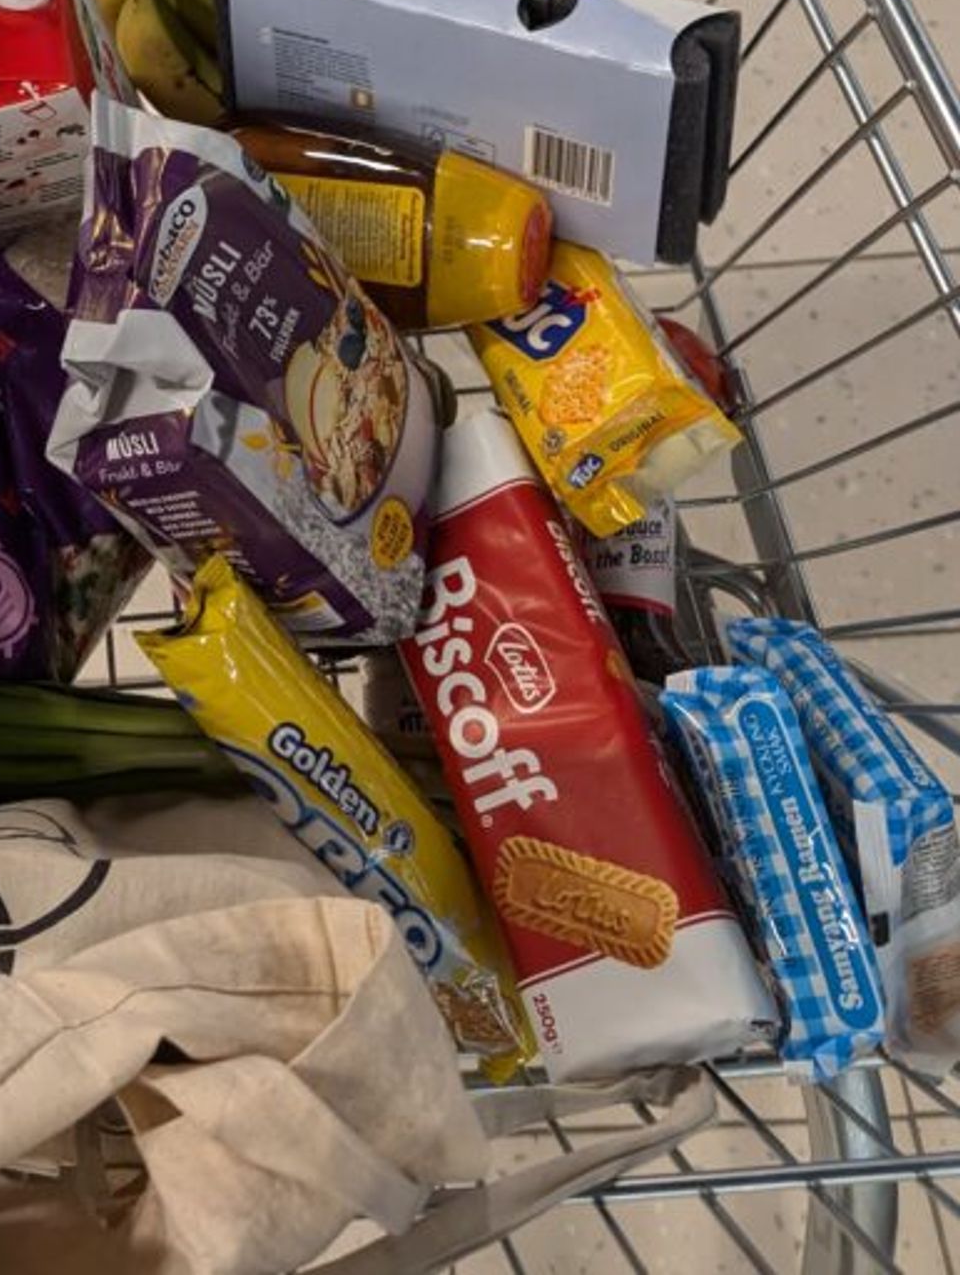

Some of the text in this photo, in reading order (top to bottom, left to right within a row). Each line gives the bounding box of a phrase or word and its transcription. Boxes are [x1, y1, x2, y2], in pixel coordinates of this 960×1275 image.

[243, 239, 274, 284] Bär
[106, 431, 160, 462] MÜSLI
[141, 461, 153, 479] &
[570, 455, 602, 487] TUC
[596, 548, 624, 569] the
[415, 556, 558, 813] Biscoff
[496, 640, 541, 703] Lotus
[743, 710, 782, 797] KYCKLING
[766, 722, 792, 775] SMAK
[271, 726, 378, 834] Golden
[781, 795, 865, 1012] Samyang Ramen
[532, 993, 558, 1043] 250g
